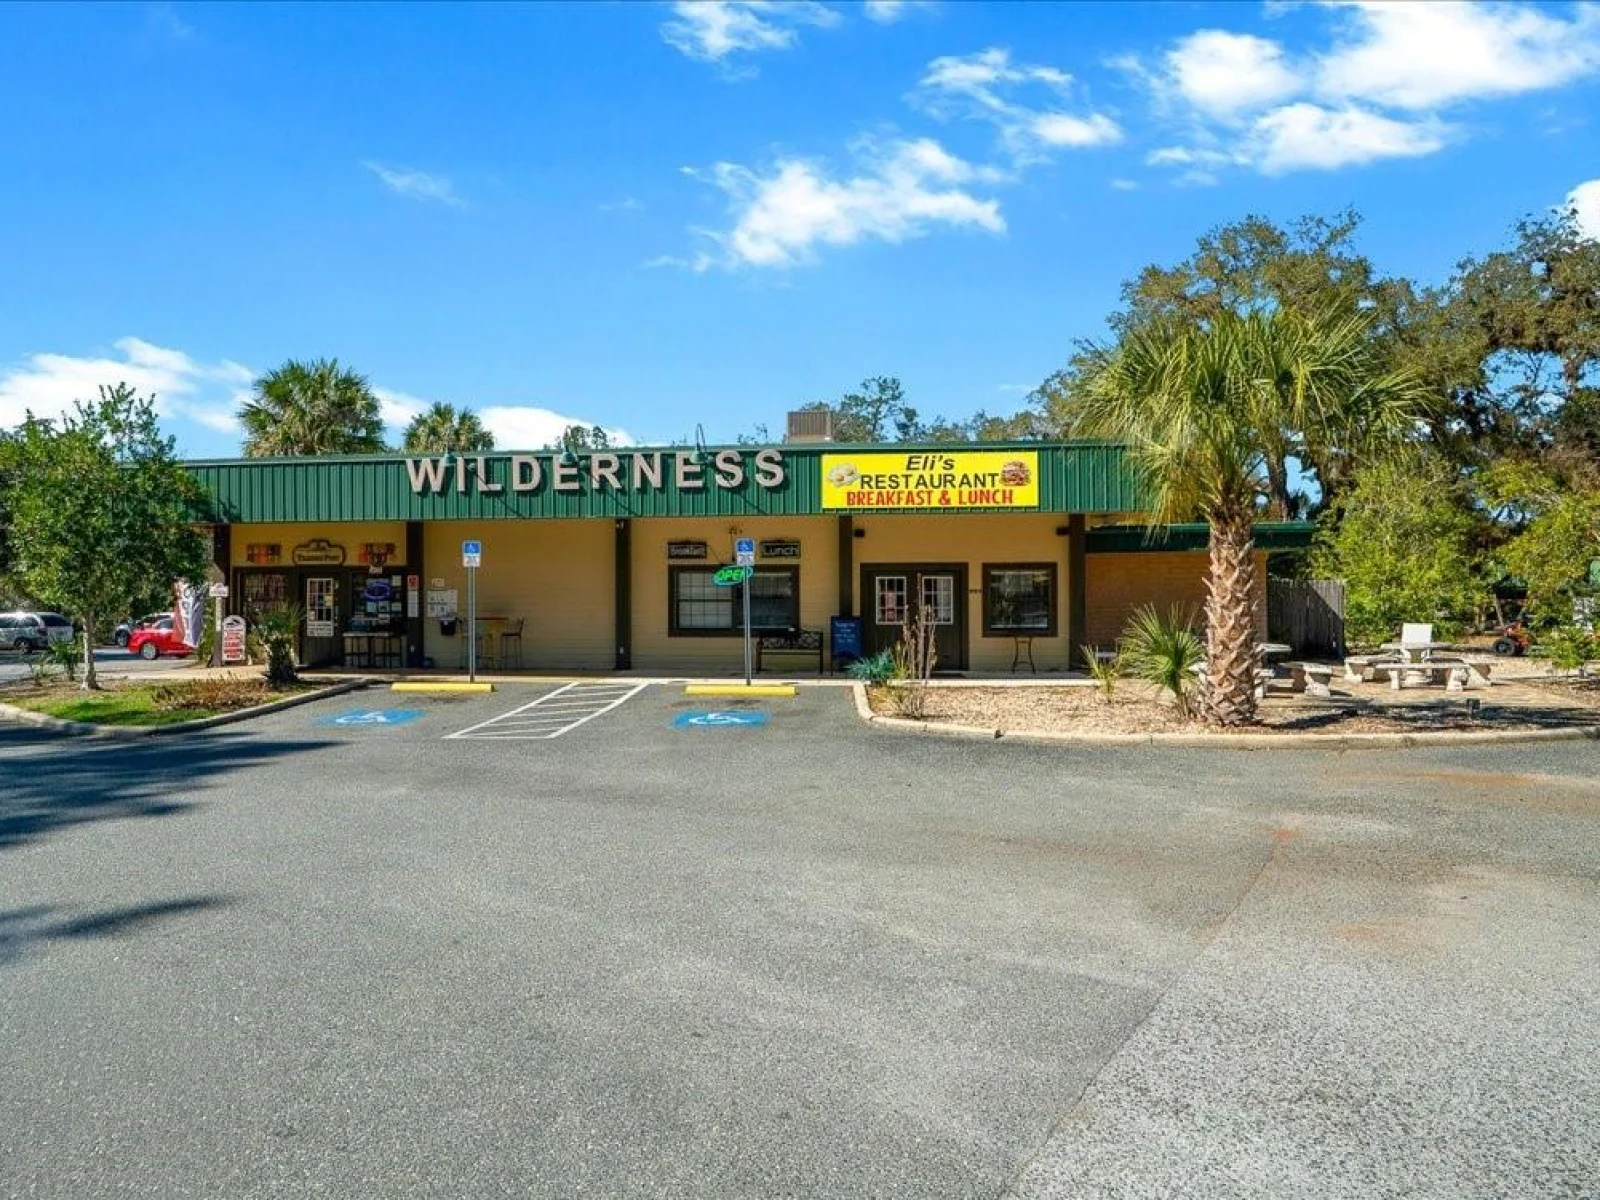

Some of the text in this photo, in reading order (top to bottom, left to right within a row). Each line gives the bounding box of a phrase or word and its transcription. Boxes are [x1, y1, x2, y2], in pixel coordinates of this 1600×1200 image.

[406, 449, 786, 493] WILDERNESS
[906, 454, 956, 471] Eli's
[860, 472, 1000, 490] RESTAURANT
[846, 488, 1013, 506] BREAKFAST & LUNCH
